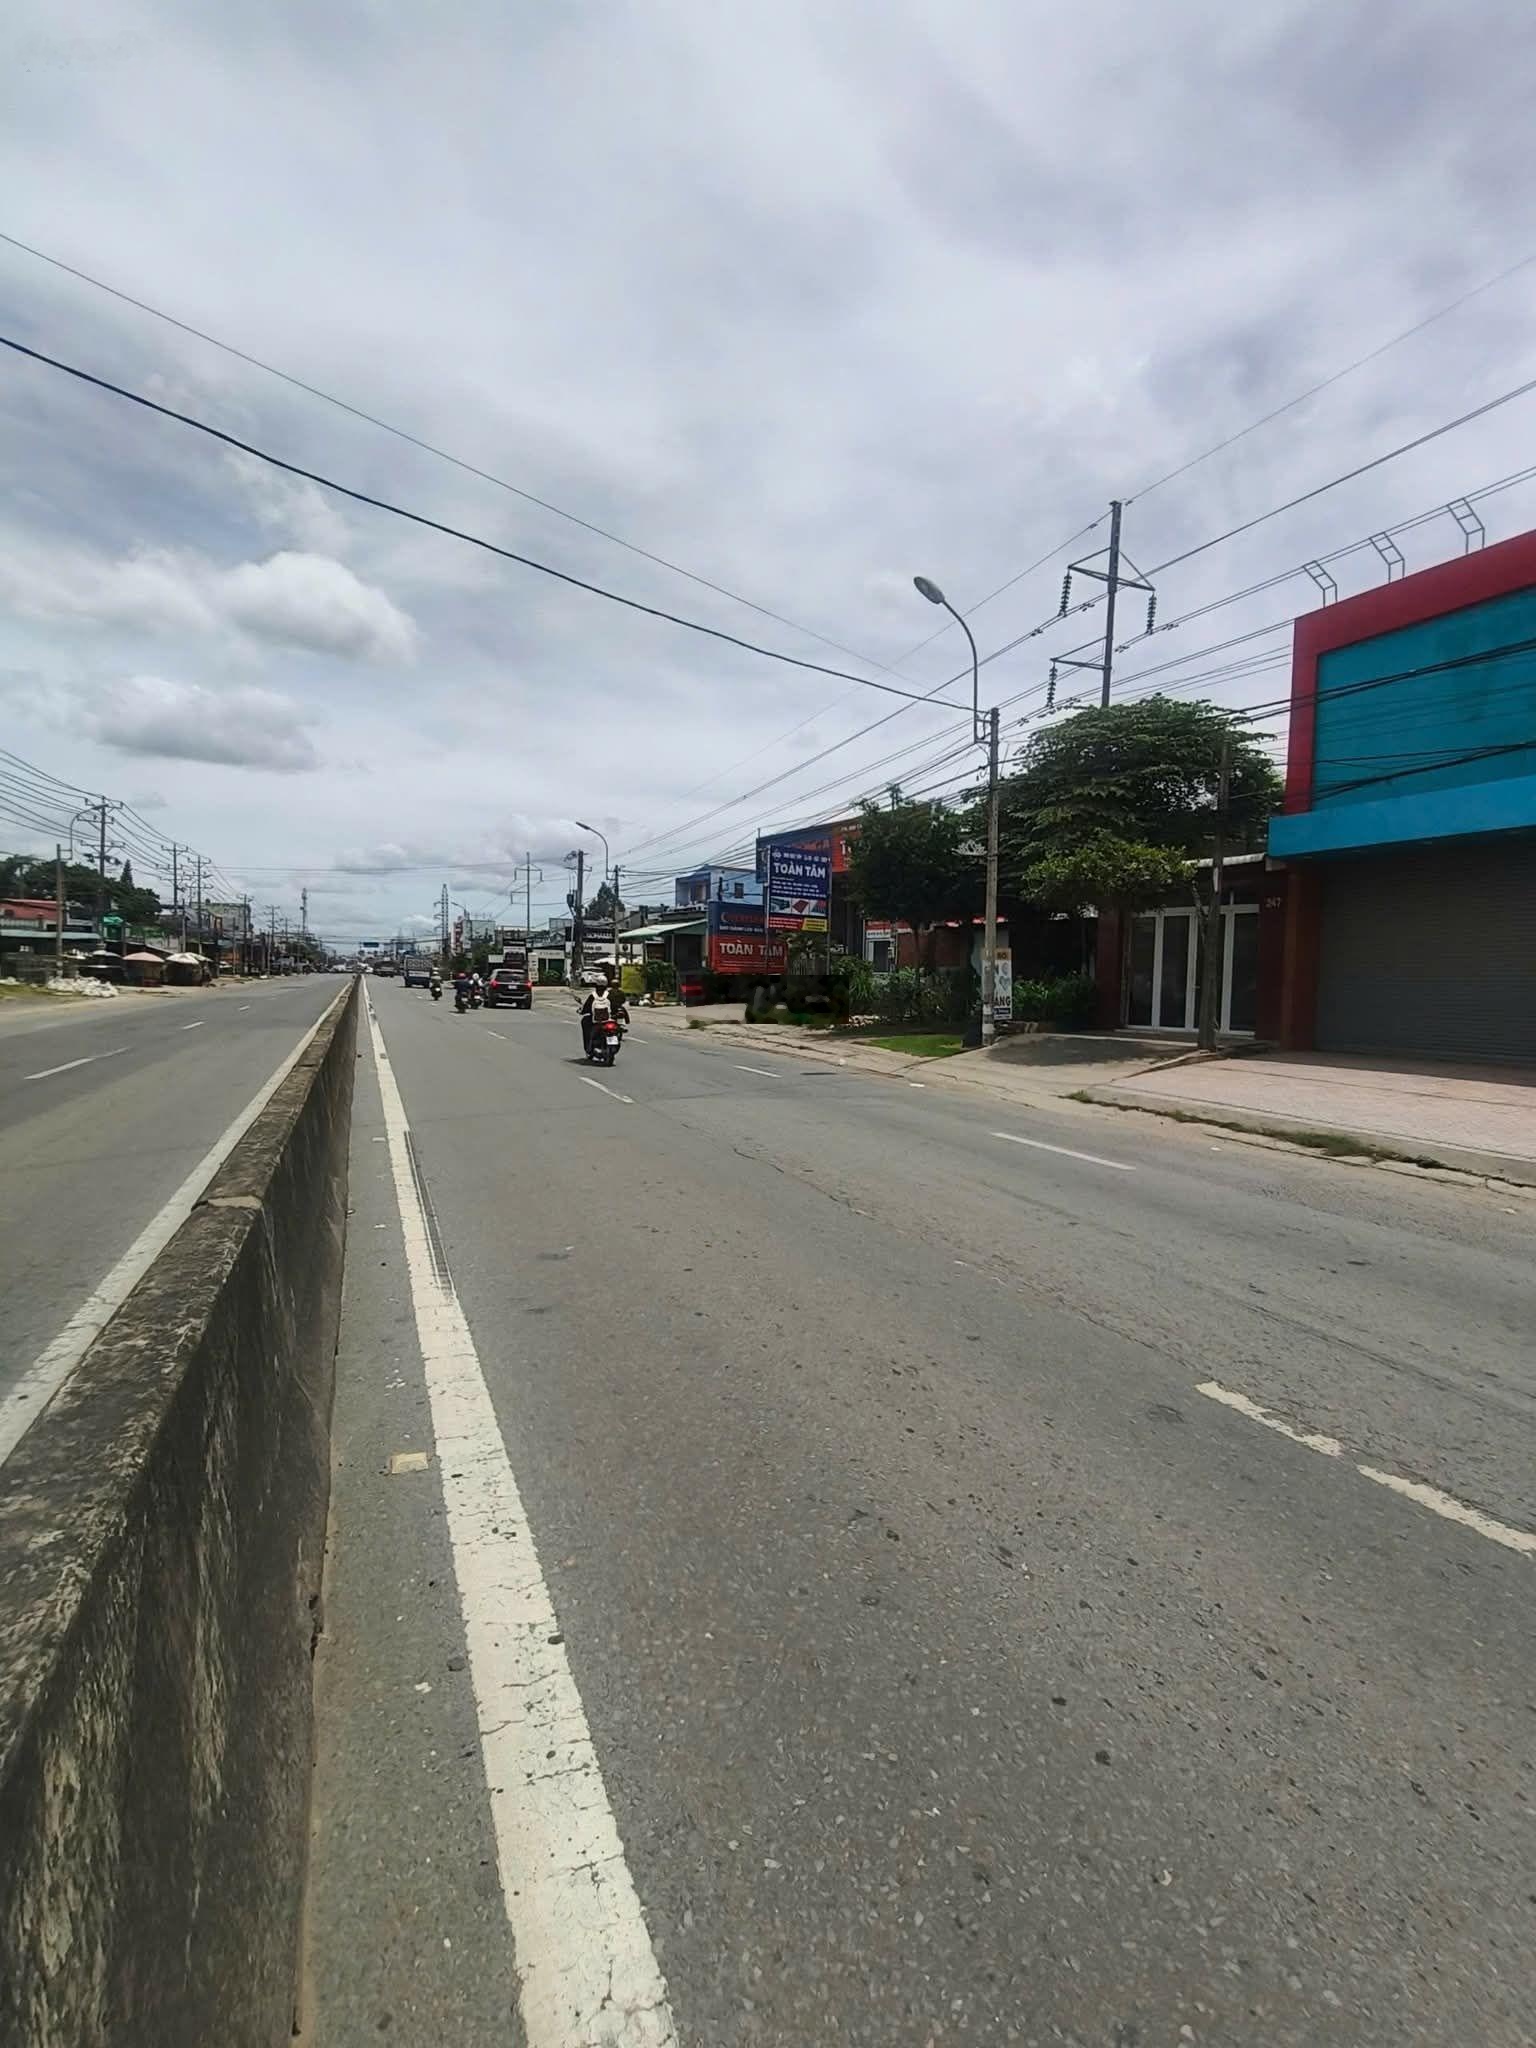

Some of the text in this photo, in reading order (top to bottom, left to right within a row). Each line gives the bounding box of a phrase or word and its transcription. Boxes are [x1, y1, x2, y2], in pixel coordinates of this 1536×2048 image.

[773, 860, 826, 879] TOÀN TÂM
[719, 939, 754, 955] TOÀN
